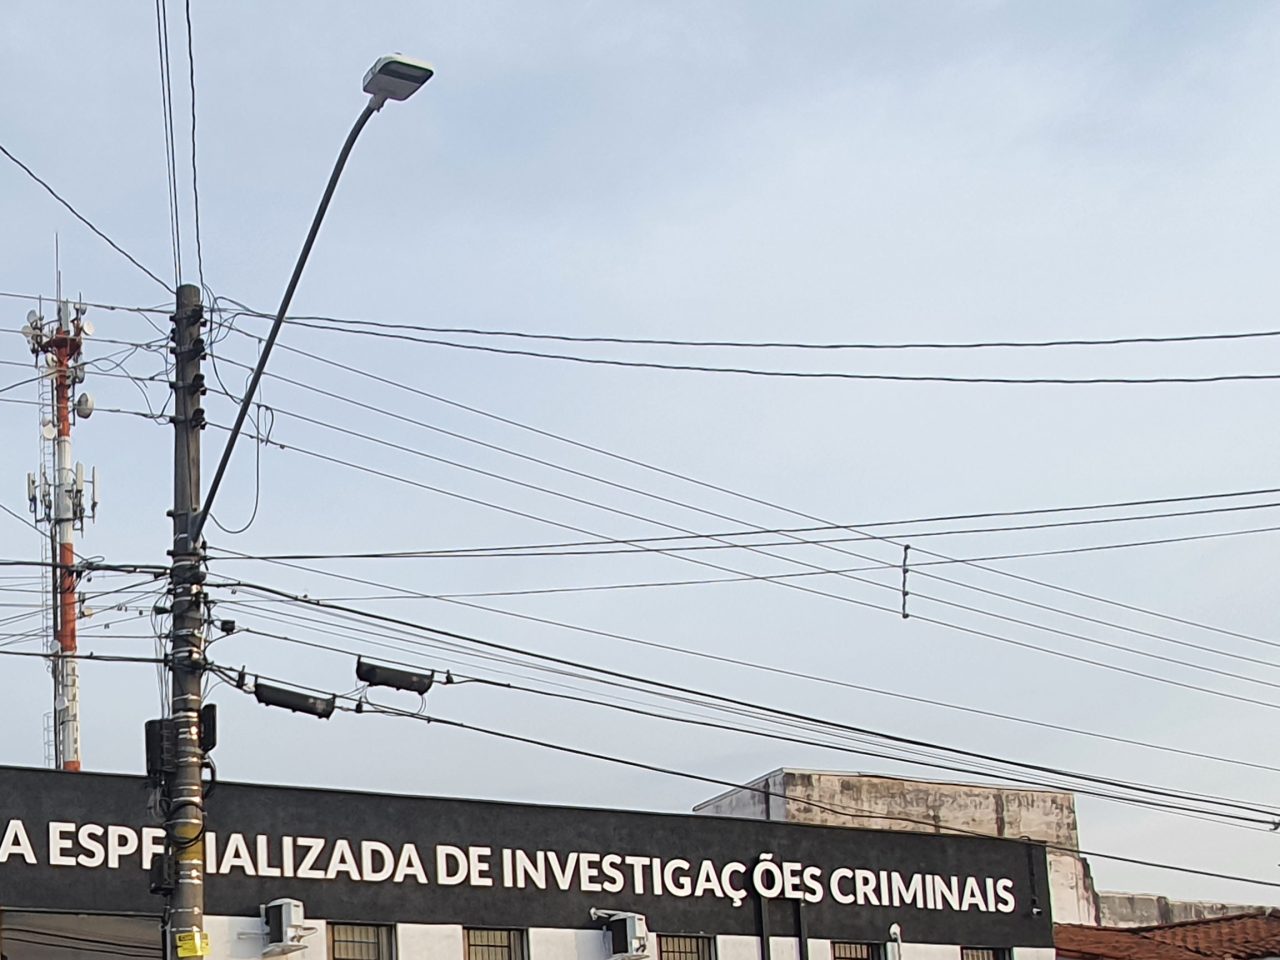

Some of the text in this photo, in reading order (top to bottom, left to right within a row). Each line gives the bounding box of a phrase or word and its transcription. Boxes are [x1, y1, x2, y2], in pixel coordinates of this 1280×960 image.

[48, 821, 429, 884] ESPEIALIZADA
[436, 844, 493, 887] DE
[502, 848, 824, 907] INVESTIGAÇÕES
[829, 867, 1016, 913] CRIMINAIS
